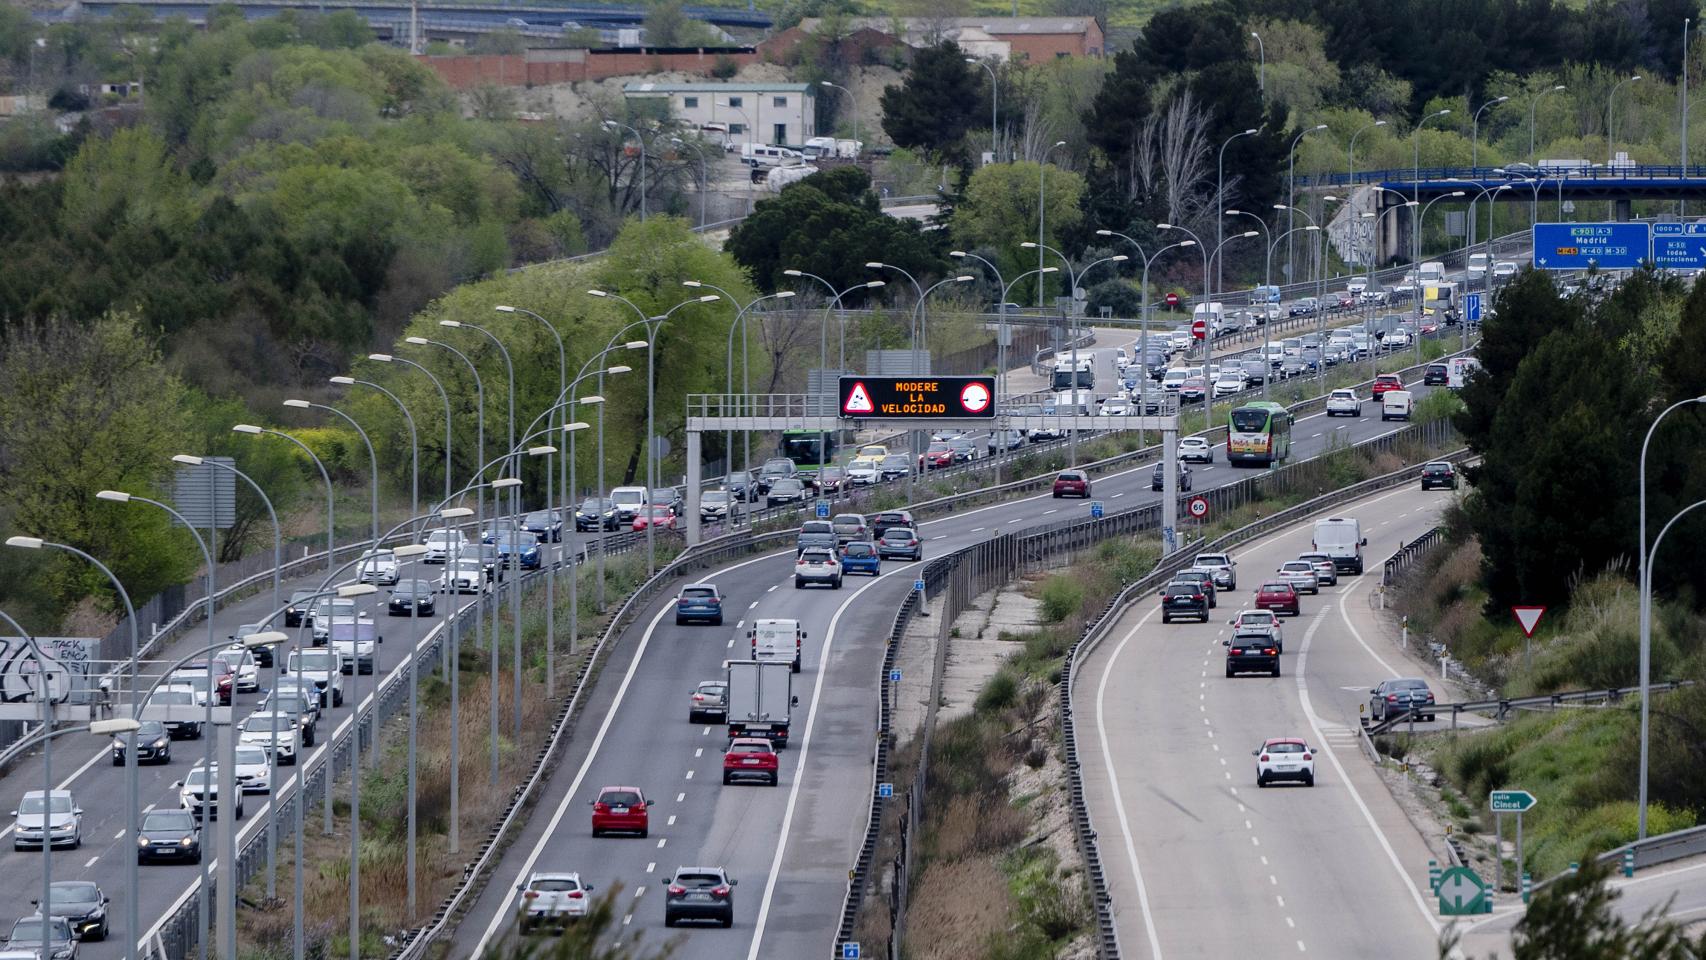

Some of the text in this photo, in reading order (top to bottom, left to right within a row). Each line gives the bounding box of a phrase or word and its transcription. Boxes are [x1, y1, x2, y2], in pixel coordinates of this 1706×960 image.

[1576, 236, 1607, 244] Madrid
[895, 382, 939, 392] MODERE
[909, 393, 924, 403] LA
[881, 404, 946, 413] VELOCIDAD
[1493, 800, 1521, 809] Cincel
